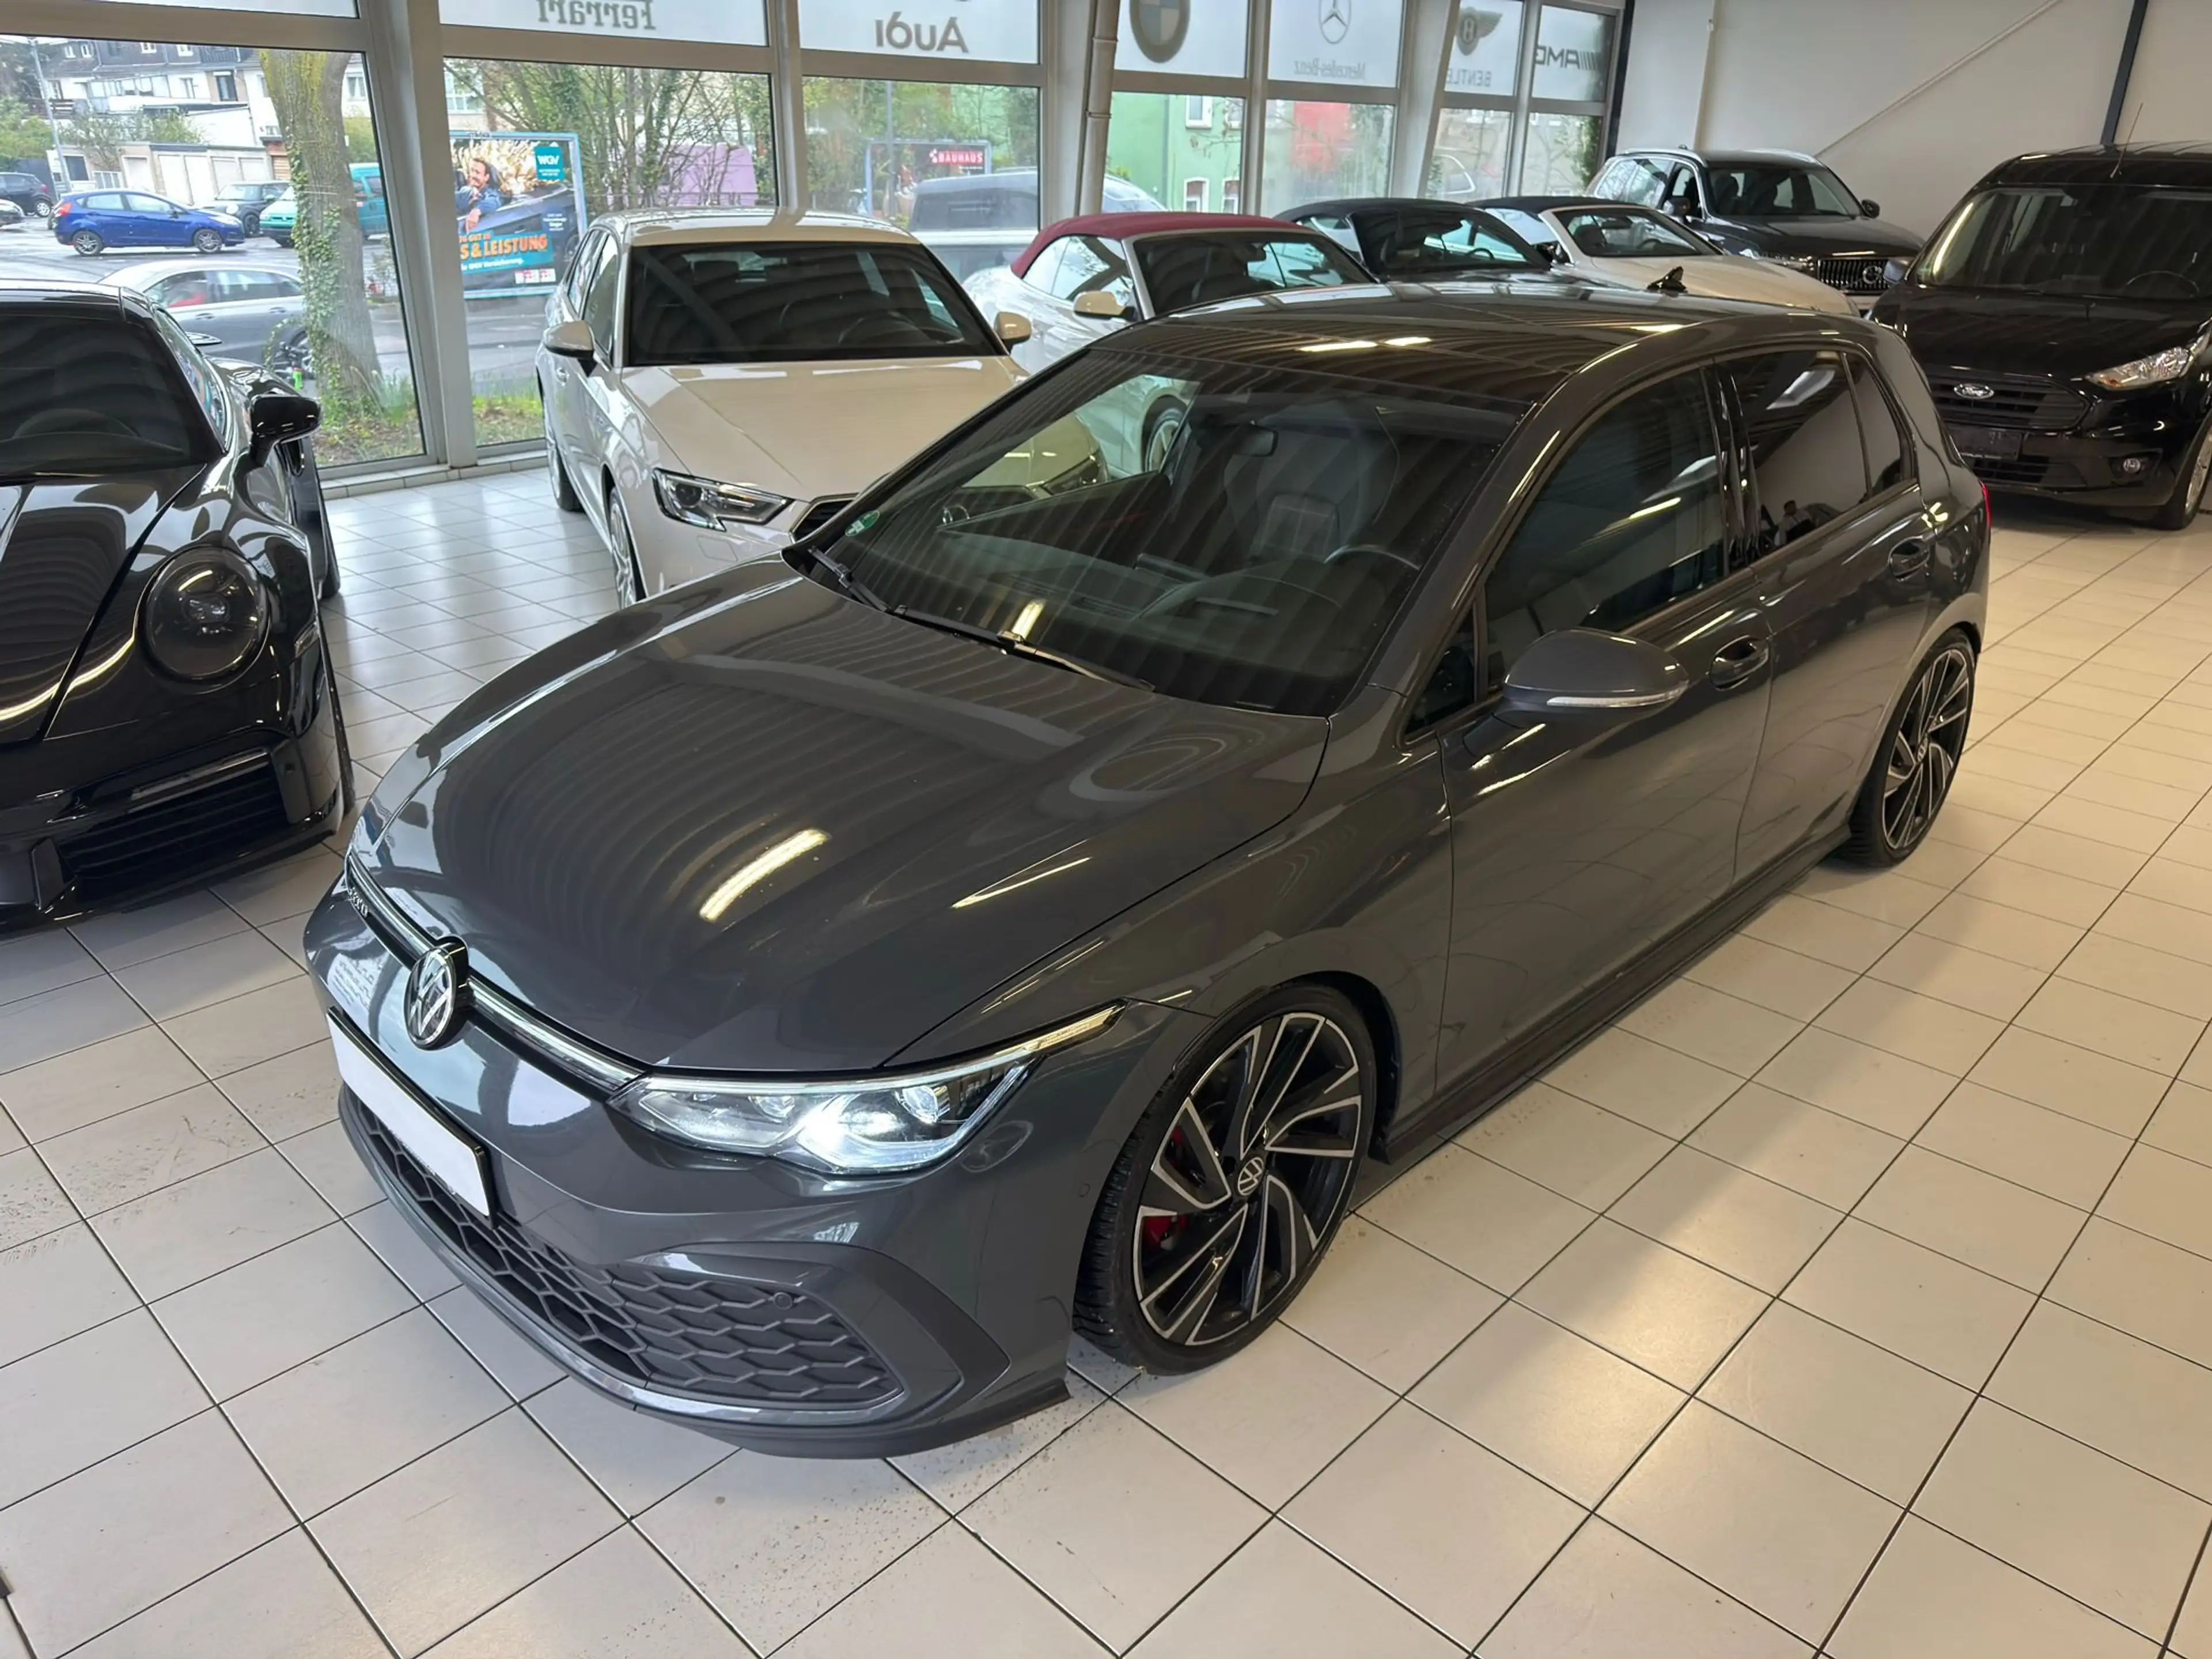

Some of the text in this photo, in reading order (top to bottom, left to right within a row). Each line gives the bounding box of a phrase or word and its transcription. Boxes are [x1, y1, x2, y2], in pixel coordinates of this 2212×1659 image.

[537, 155, 560, 165] WGV
[938, 151, 983, 163] BAUHAUS
[471, 243, 482, 257] &
[484, 233, 548, 256] LEISTUNG
